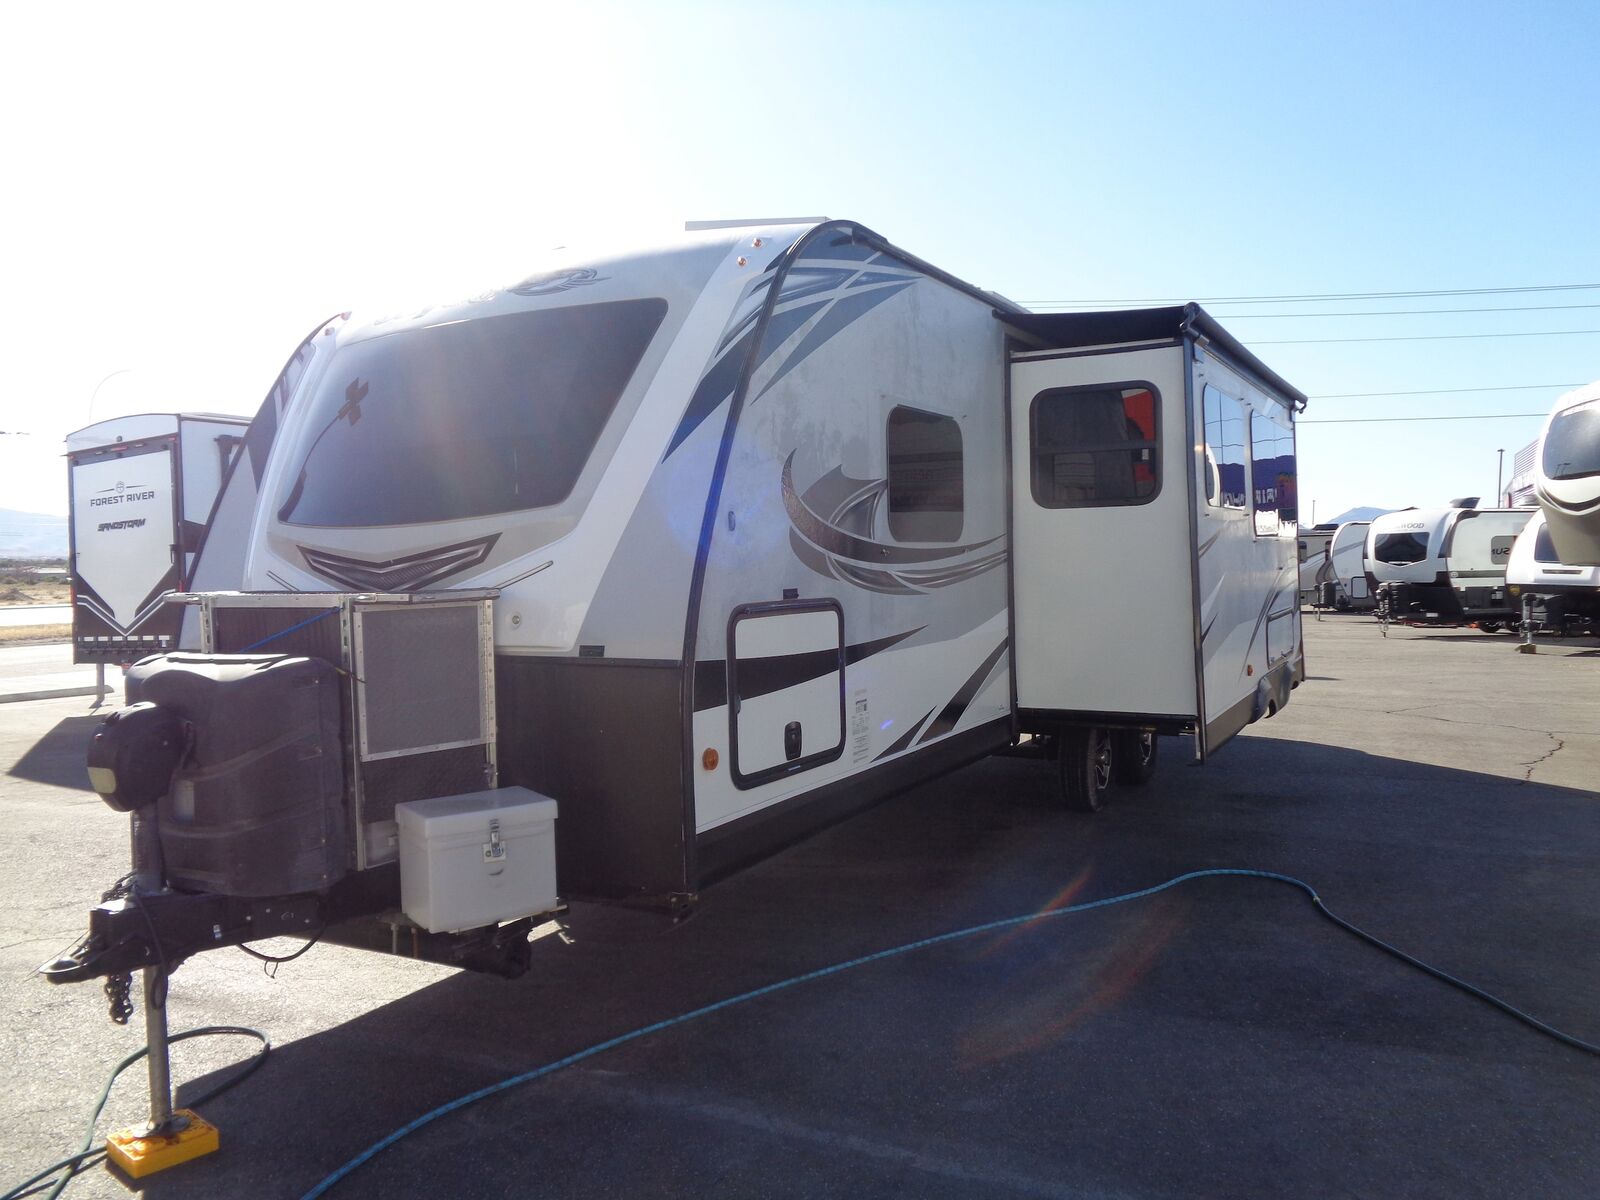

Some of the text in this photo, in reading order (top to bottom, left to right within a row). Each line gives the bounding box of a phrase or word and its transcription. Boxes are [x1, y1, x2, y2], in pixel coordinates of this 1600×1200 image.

[90, 490, 154, 507] FOREST RIVER
[98, 518, 146, 531] SANDSTORM
